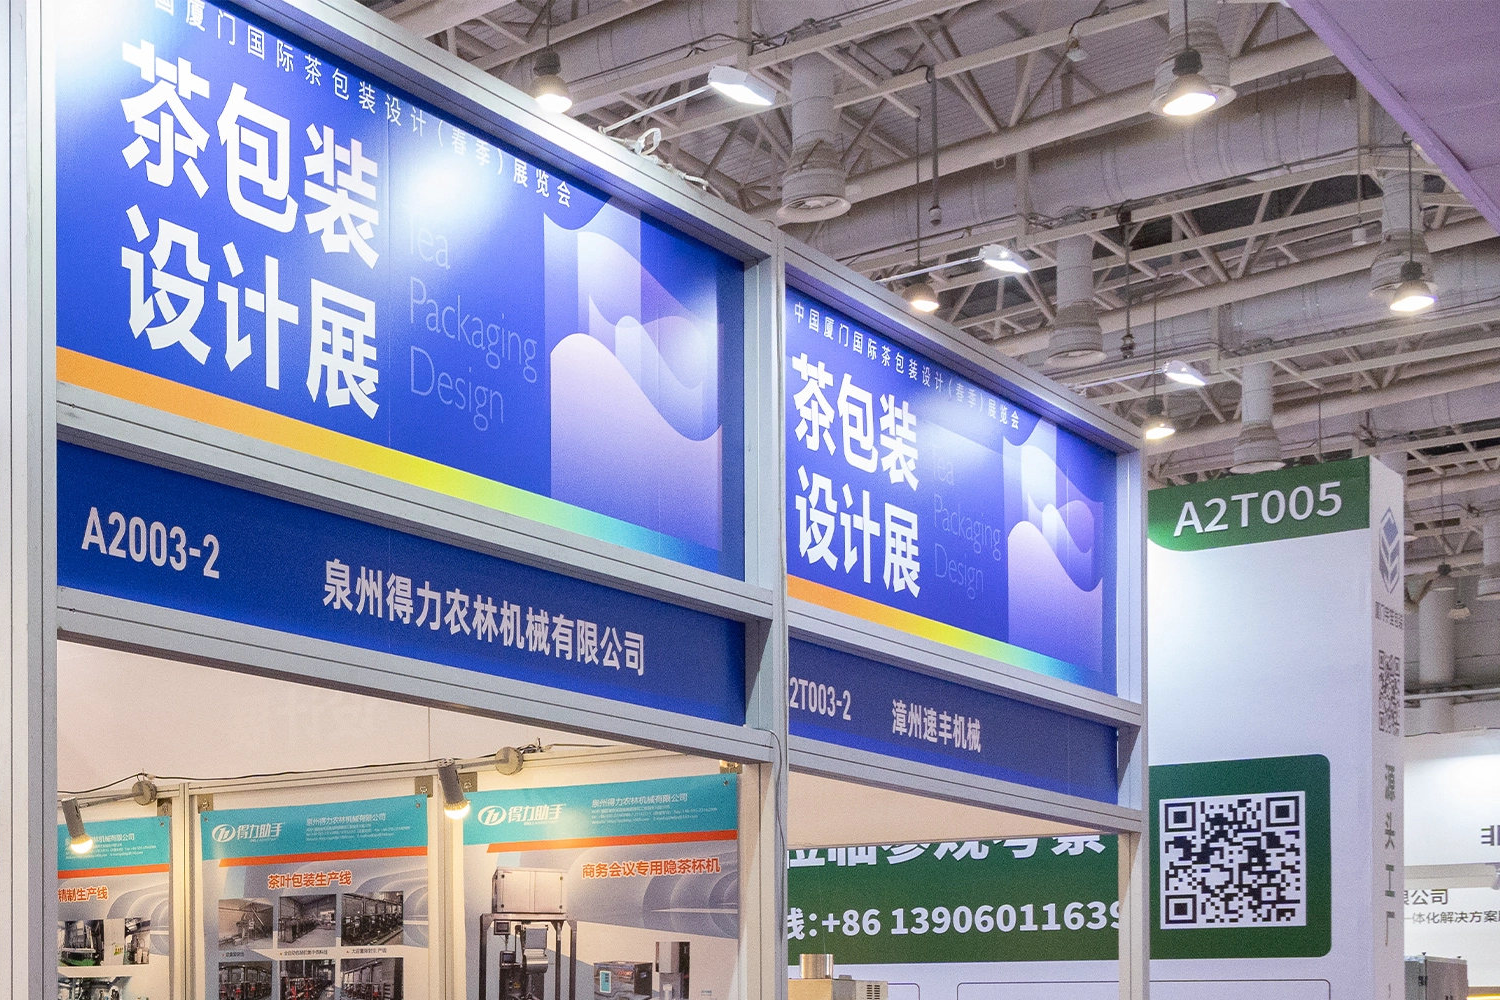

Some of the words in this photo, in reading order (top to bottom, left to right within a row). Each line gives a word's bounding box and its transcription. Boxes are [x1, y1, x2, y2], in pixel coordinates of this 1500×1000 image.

[120, 39, 379, 270] 茶包装
[121, 204, 380, 420] 设计展
[409, 276, 538, 383] Packaging
[409, 345, 504, 431] Design
[791, 352, 918, 492] 茶包装
[80, 506, 220, 580] A2003-2
[794, 465, 921, 598] 设计展
[933, 493, 1001, 562] Packaging
[1173, 480, 1342, 537] A2T005
[934, 542, 984, 600] Design
[322, 558, 645, 677] 泉州得力农林机械有限公司
[787, 676, 852, 721] 2T003-2
[891, 699, 982, 753] 漳州速丰机械
[237, 822, 283, 841] 得力助手
[507, 803, 564, 824] 得力助手
[267, 869, 352, 889] 茶叶包装生产线
[581, 856, 721, 880] 商务会议专用隐茶杯机
